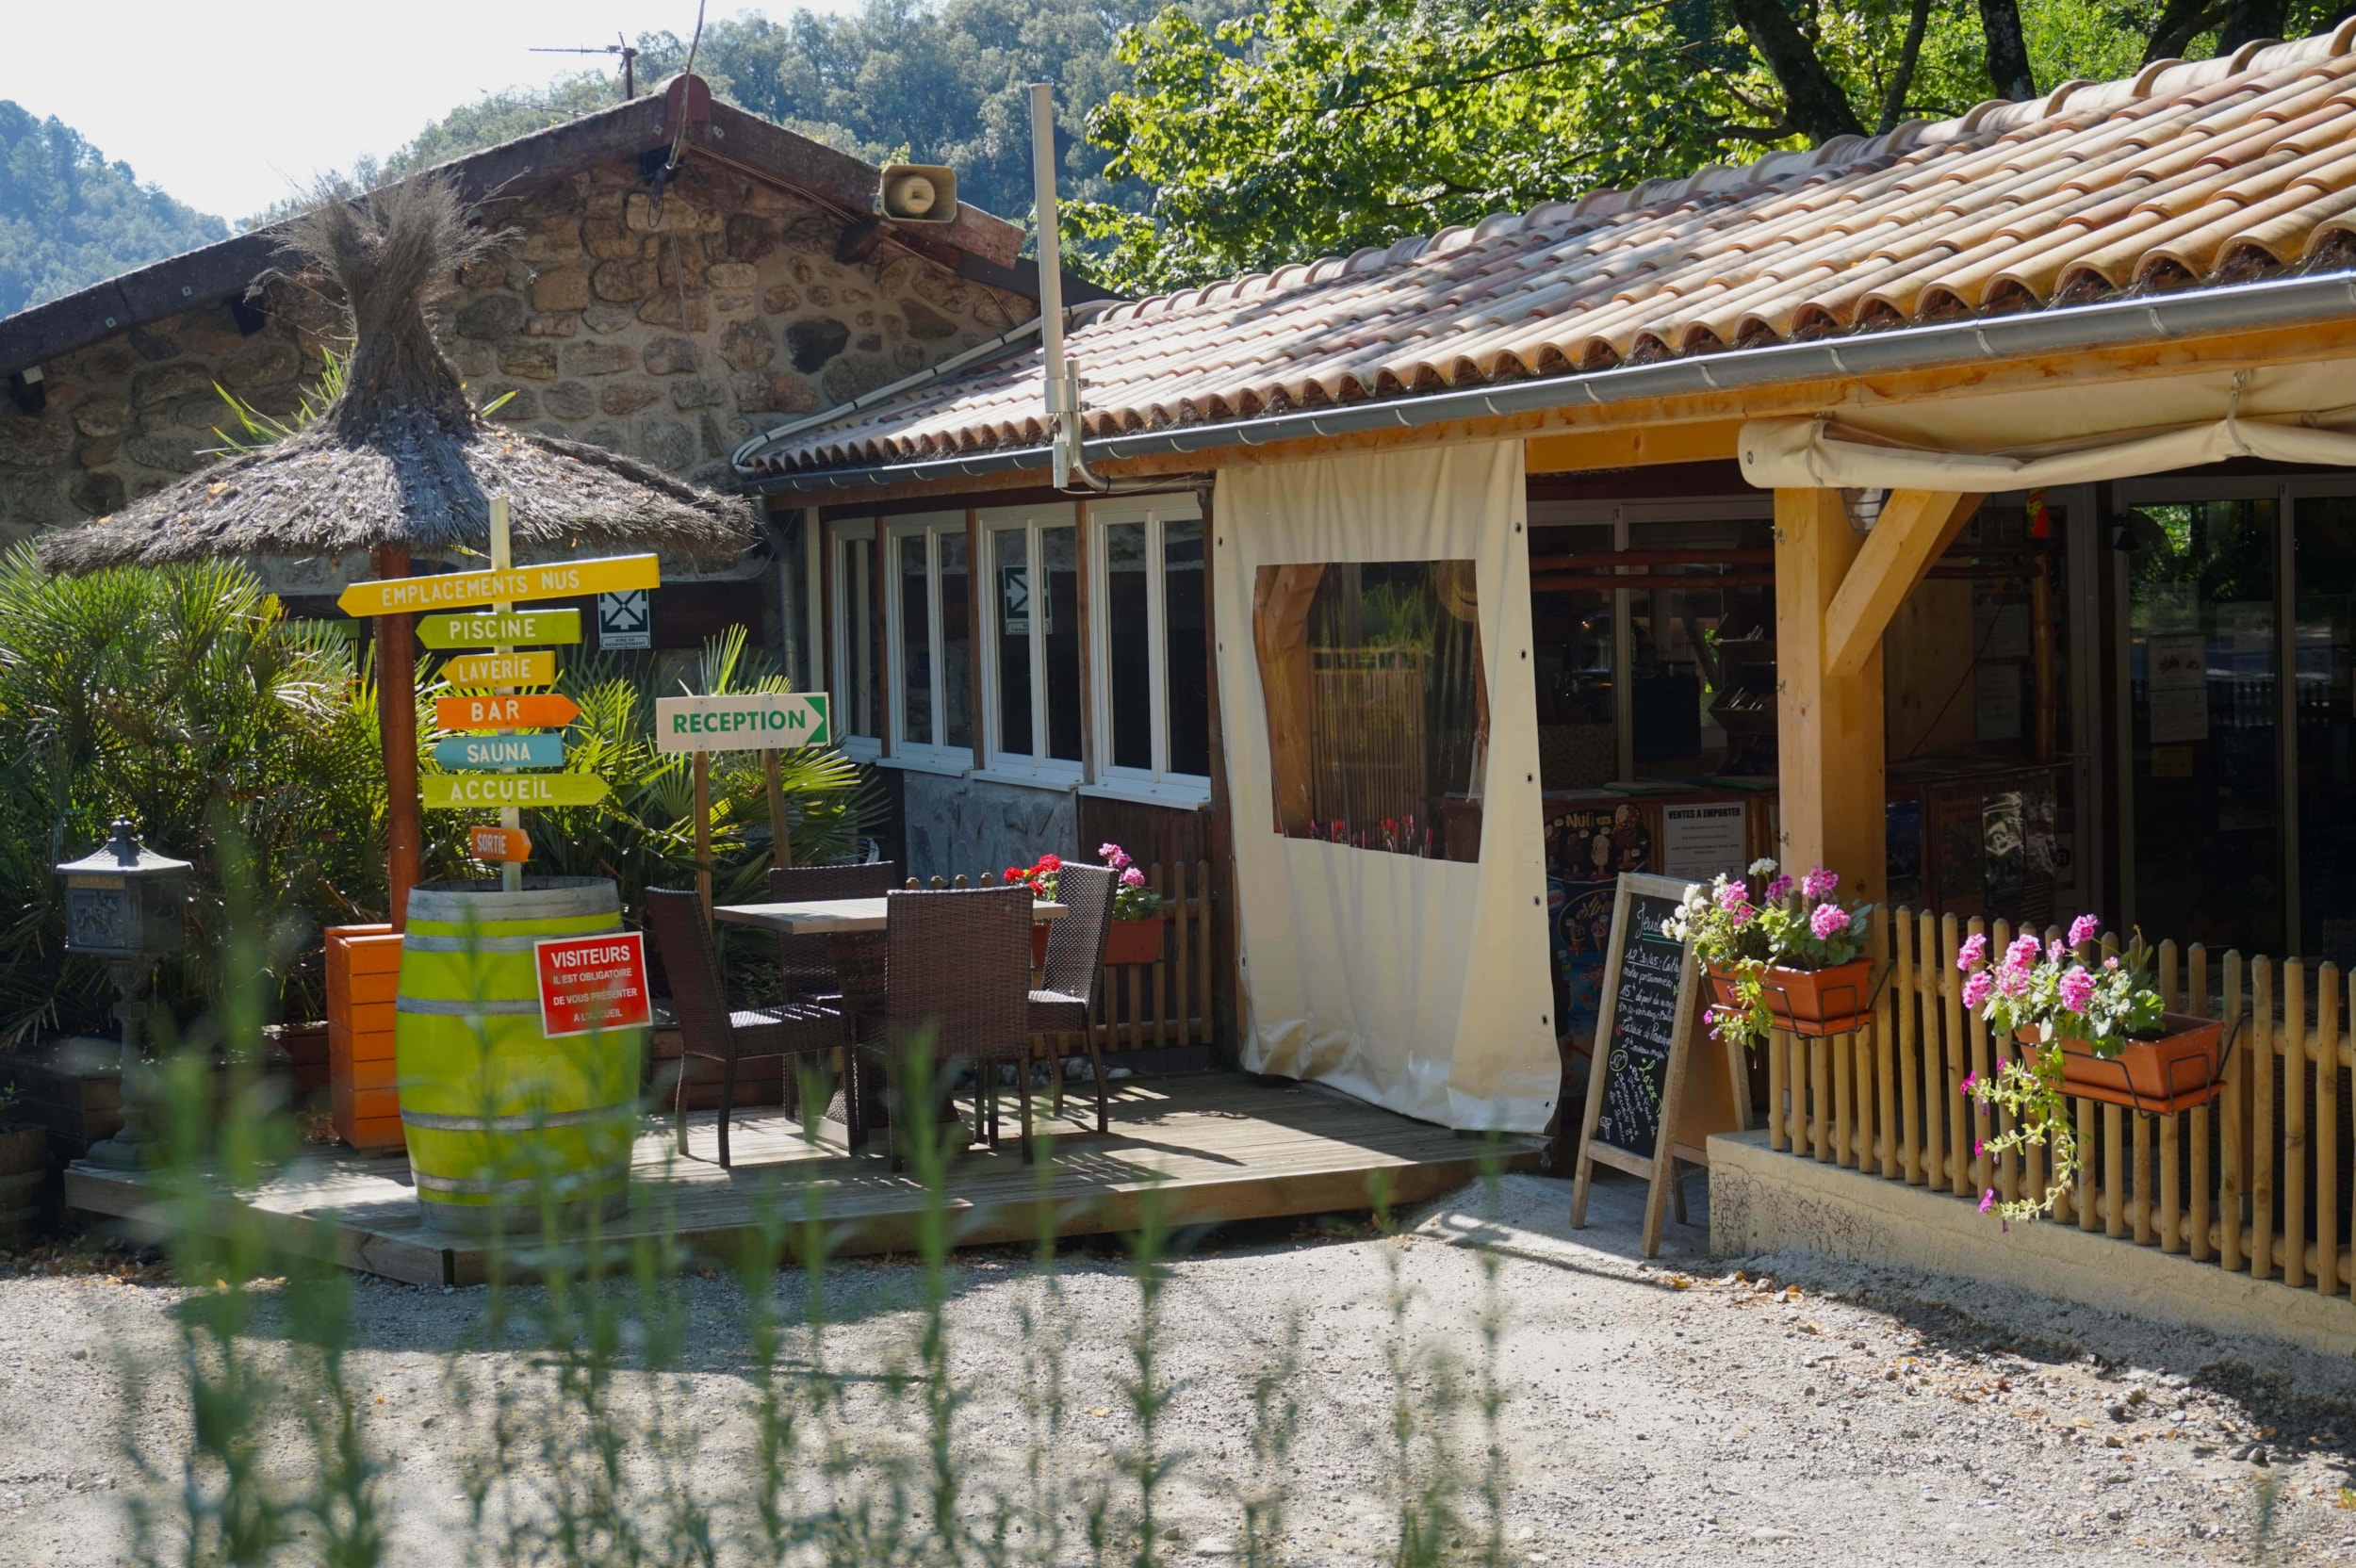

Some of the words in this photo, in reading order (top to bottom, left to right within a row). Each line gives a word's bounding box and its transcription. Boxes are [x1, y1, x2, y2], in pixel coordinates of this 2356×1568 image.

[381, 575, 529, 607] EMPLACEMENTS
[541, 569, 581, 590] NUS
[449, 618, 536, 640] PISCINE
[471, 699, 520, 722] BAR
[673, 710, 806, 733] RECEPTION
[466, 742, 532, 763] SAUNA
[1668, 809, 1695, 820] VENTES
[1703, 807, 1742, 818] EMPORTER
[550, 945, 630, 969] VISITEURS
[552, 975, 561, 986] IL
[563, 973, 578, 985] EST
[579, 968, 632, 982] OBLIGATOIRE
[553, 995, 565, 1006] DE
[565, 993, 589, 1004] VOUS
[573, 1013, 580, 1022] A
